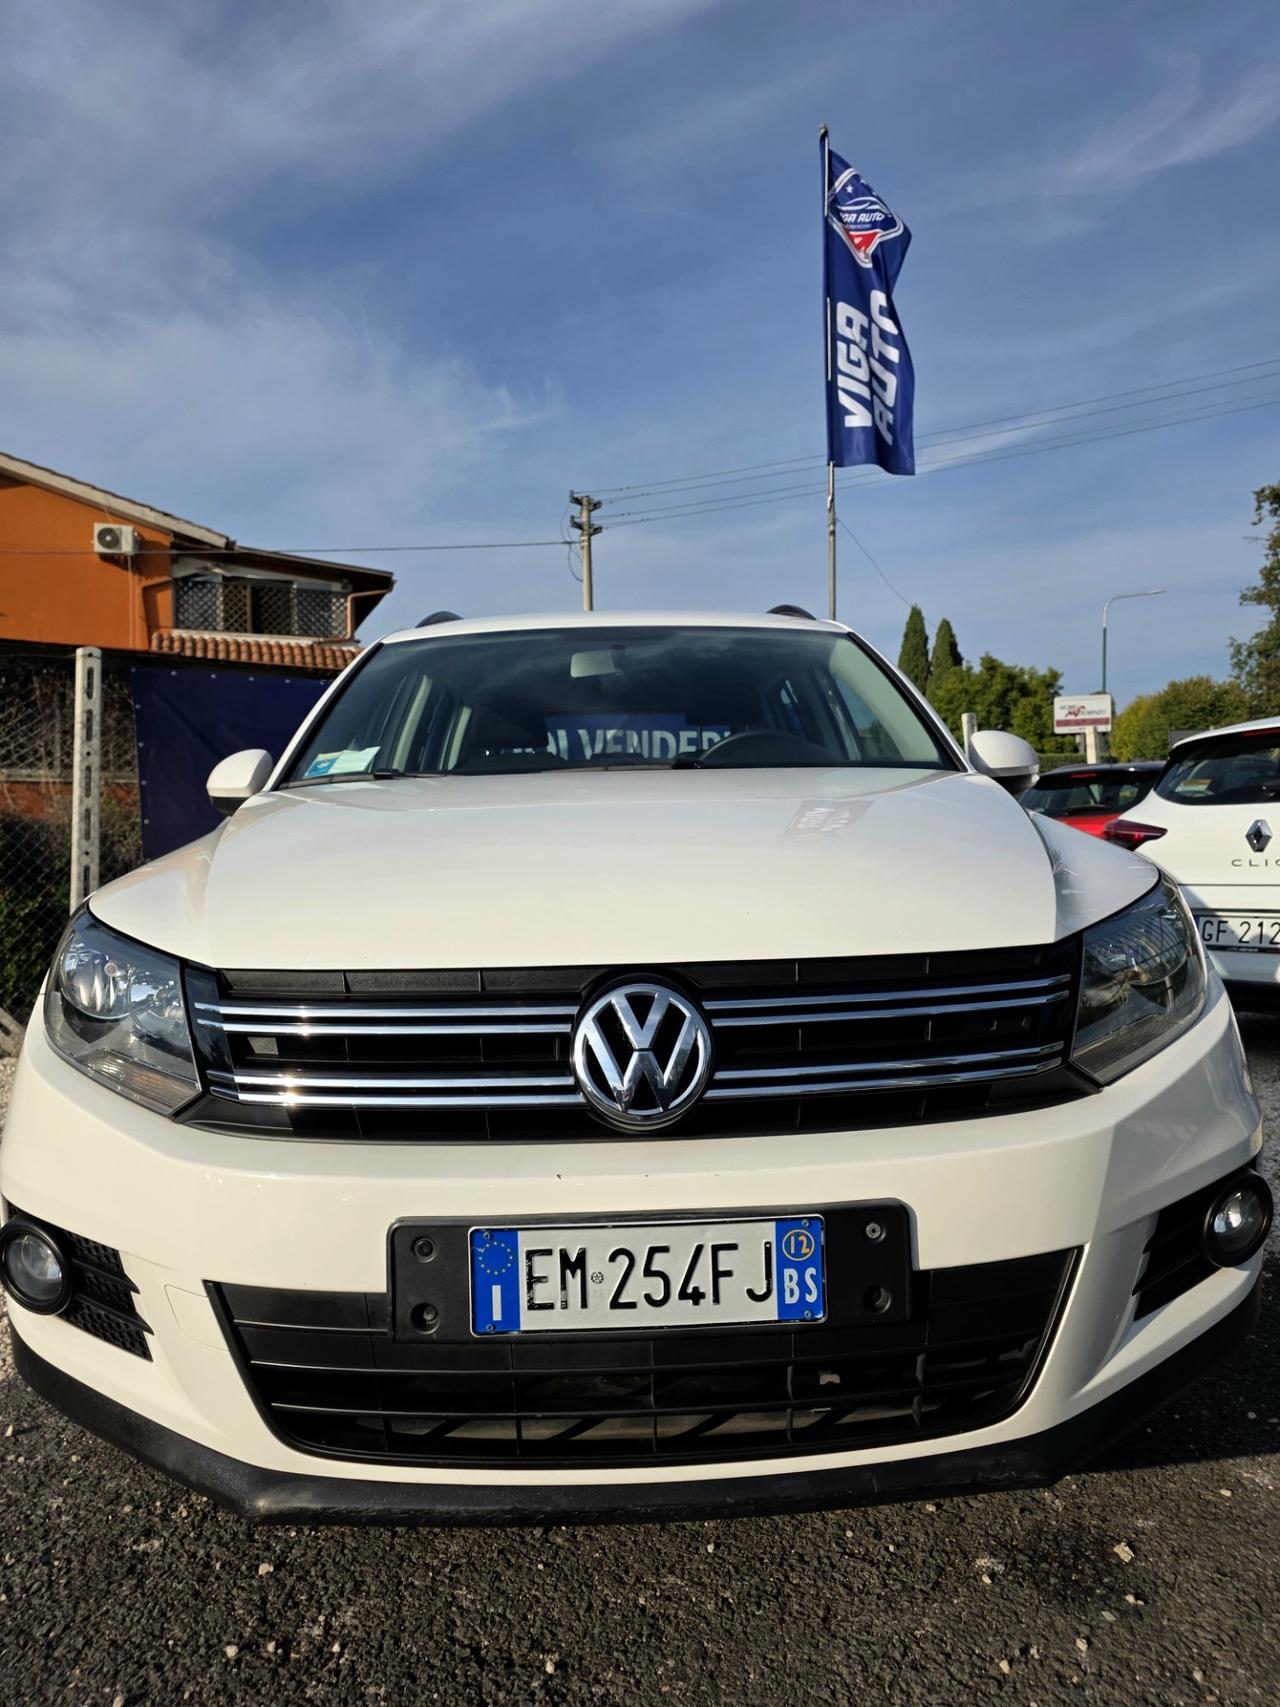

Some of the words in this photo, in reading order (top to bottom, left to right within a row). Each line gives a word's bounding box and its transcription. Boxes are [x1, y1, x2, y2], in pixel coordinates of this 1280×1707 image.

[857, 212, 886, 222] AUTO
[836, 301, 873, 428] VIGA
[577, 729, 731, 760] VENDER
[1202, 919, 1229, 944] GF
[789, 1234, 811, 1255] 12
[524, 1247, 589, 1311] EM
[608, 1240, 773, 1311] 254FJ
[783, 1267, 818, 1305] BS
